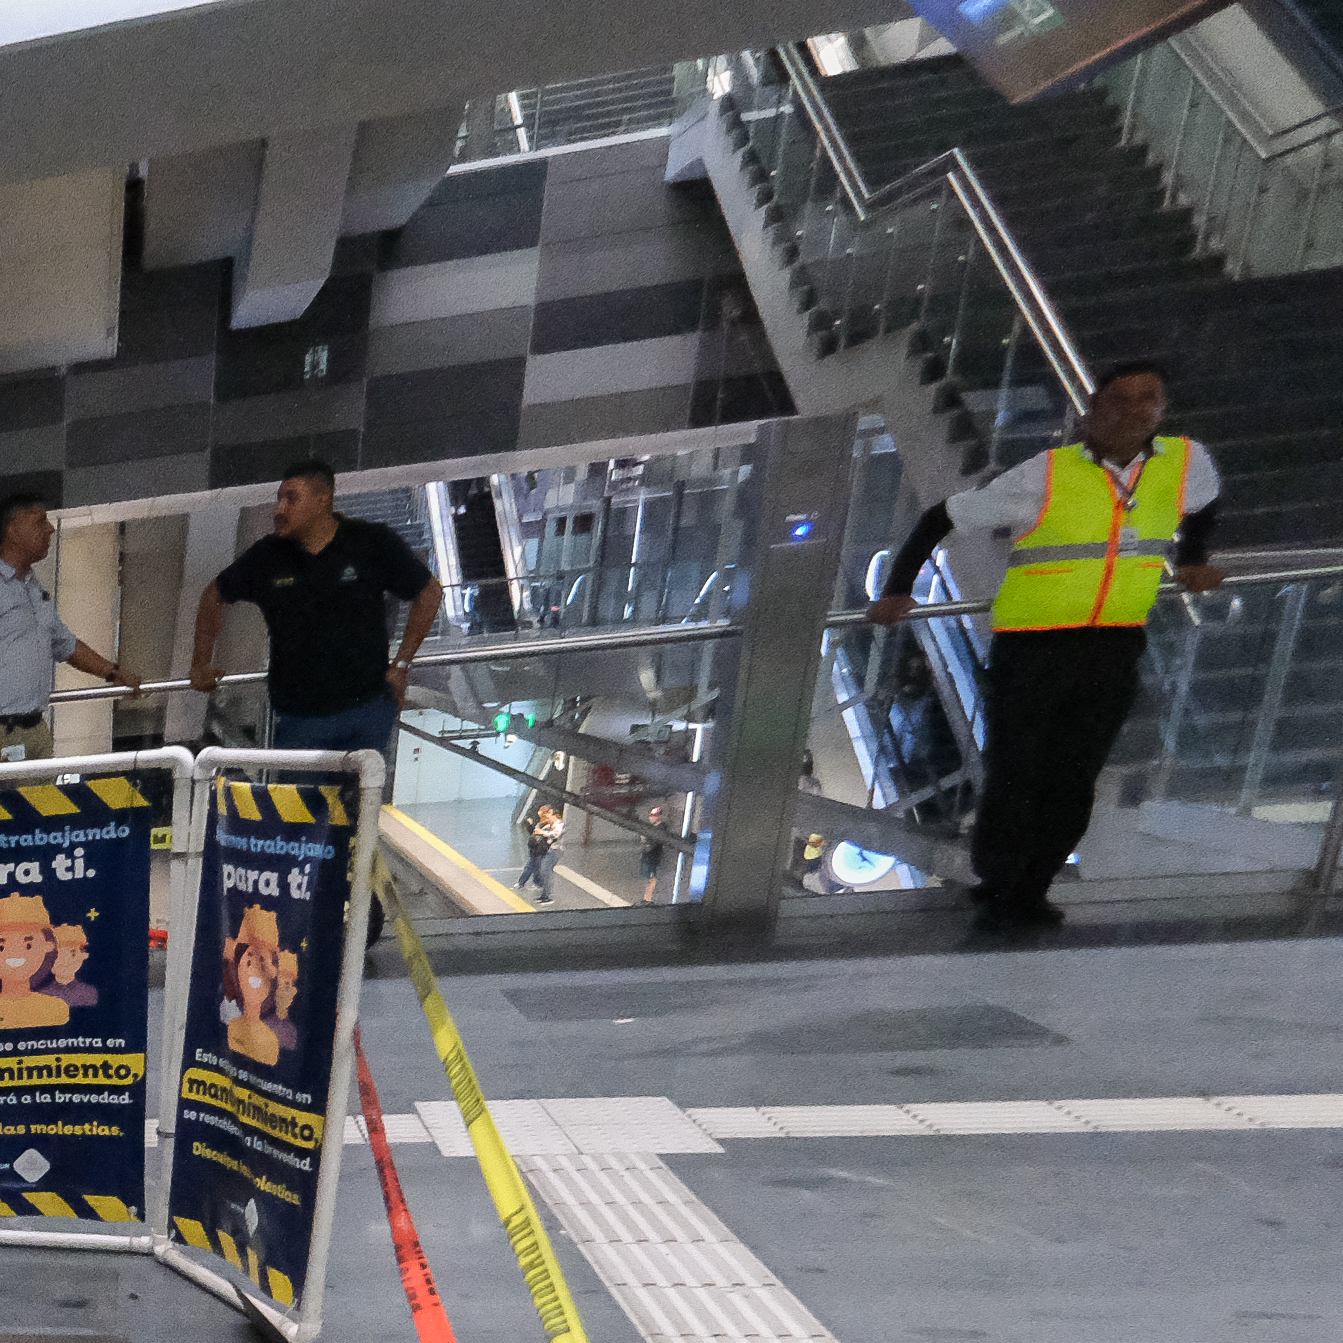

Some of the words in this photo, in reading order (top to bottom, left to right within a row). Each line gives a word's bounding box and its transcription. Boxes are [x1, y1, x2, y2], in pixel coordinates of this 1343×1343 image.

[51, 847, 96, 881] ti.
[222, 863, 280, 896] para
[287, 863, 311, 900] ti.
[17, 1036, 102, 1050] encuentra
[106, 1037, 126, 1048] en
[20, 1093, 32, 1104] a
[35, 1091, 52, 1103] la
